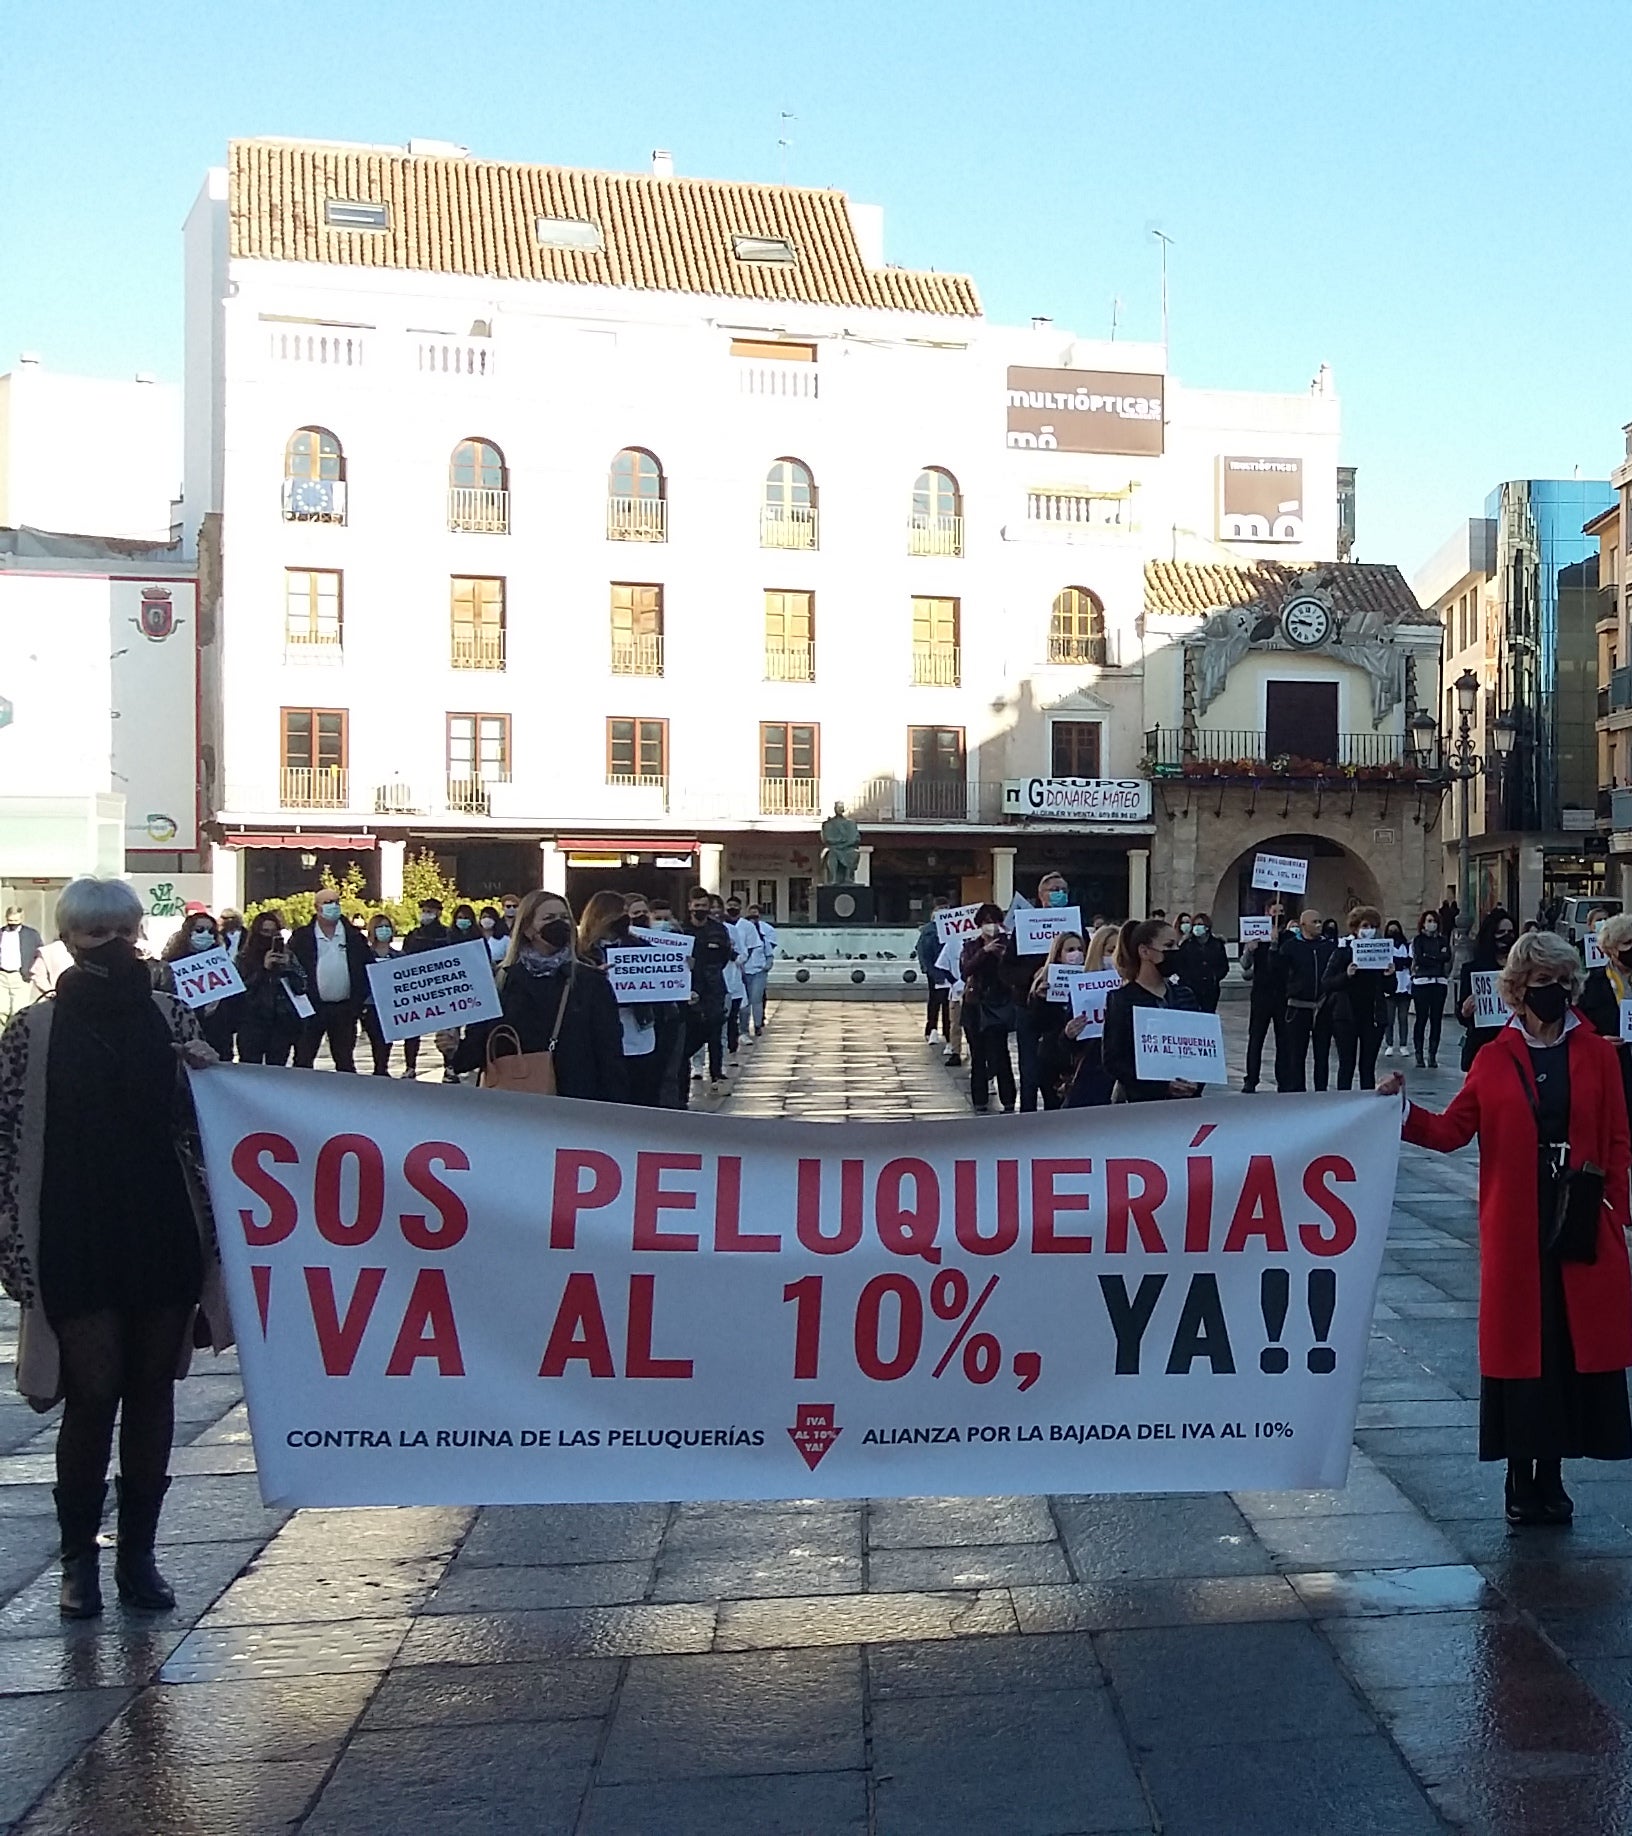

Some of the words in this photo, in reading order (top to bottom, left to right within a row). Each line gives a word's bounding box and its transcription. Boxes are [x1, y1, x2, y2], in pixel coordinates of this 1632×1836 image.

[1046, 789, 1099, 808] DONAIRE
[1102, 790, 1140, 808] MATEO
[191, 962, 205, 972] AL
[614, 953, 684, 964] SERVICIOS
[393, 957, 461, 980] QUEREMOS
[614, 965, 684, 975] ESENCIALES
[181, 967, 233, 998] ¡YA!
[394, 970, 467, 994] RECUPERAR
[615, 981, 636, 990] IVA
[639, 981, 656, 990] AL
[660, 980, 685, 989] 10%
[1475, 976, 1492, 995] SOS
[393, 996, 410, 1008] LO
[412, 983, 474, 1003] NUESTRO:
[393, 1012, 421, 1026] IVA
[425, 1005, 446, 1018] AL
[449, 997, 482, 1012] 10%
[1478, 998, 1494, 1016] IVA
[1141, 1034, 1158, 1044] SOS
[1162, 1035, 1216, 1048] PELUQUERÍAS
[1143, 1044, 1159, 1053] IVA
[1162, 1045, 1174, 1054] AL
[231, 1132, 471, 1250] SOS
[549, 1124, 1358, 1264] PELUQUERÍAS
[538, 1273, 694, 1378] AL
[783, 1268, 1042, 1391] 10%,
[1097, 1268, 1337, 1375] YA!!
[806, 1417, 826, 1425] IVA
[286, 1430, 392, 1448] CONTRA
[399, 1430, 428, 1447] LA
[436, 1430, 513, 1447] RUINA
[521, 1430, 551, 1447] DE
[558, 1429, 601, 1446] LAS
[607, 1425, 765, 1448] PELUQUERÍAS
[795, 1431, 810, 1439] AL
[814, 1430, 837, 1439] 10%
[862, 1427, 961, 1444] ALIANZA
[967, 1426, 1012, 1442] POR
[1017, 1425, 1044, 1441] LA
[1049, 1424, 1131, 1443] BAJADA
[1137, 1423, 1176, 1440] DEL
[1181, 1423, 1215, 1439] IVA
[1220, 1422, 1247, 1439] AL
[1254, 1421, 1294, 1438] 10%
[805, 1443, 823, 1452] YA!
